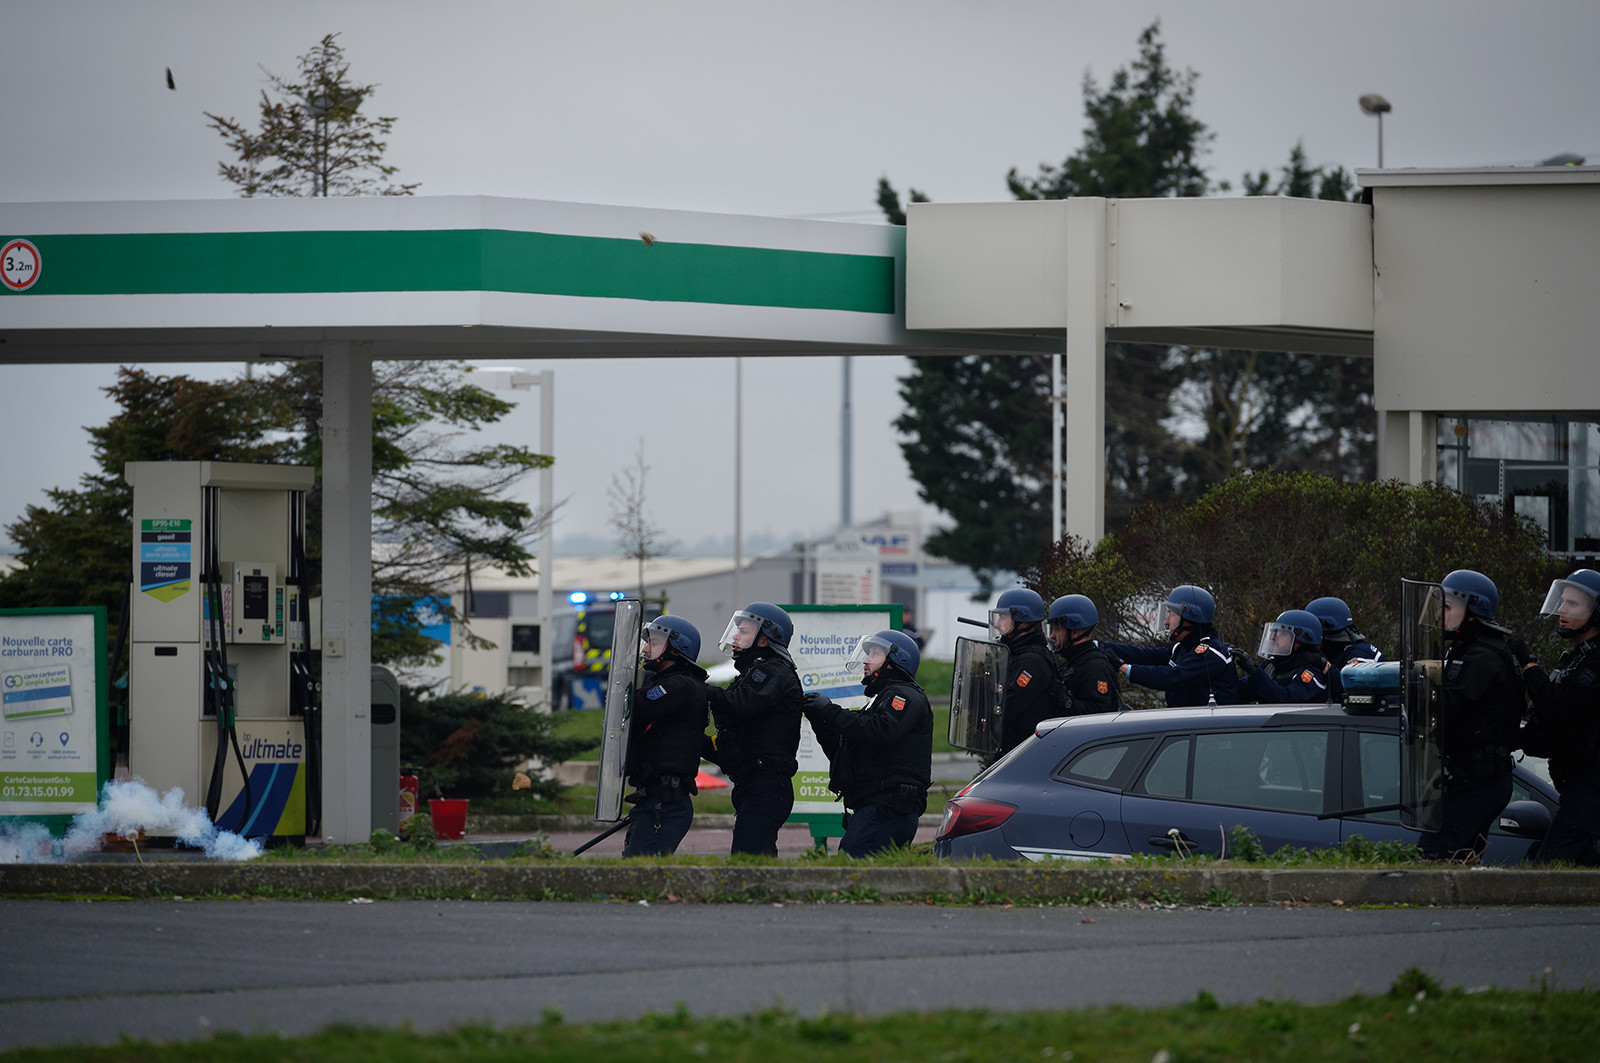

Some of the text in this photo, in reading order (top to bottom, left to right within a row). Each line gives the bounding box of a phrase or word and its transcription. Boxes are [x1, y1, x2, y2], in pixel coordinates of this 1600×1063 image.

[6, 257, 32, 271] 3.2m
[2, 636, 73, 646] Nouvelle carte
[800, 635, 842, 644] Nouvelle
[2, 647, 73, 656] carburant PRO
[800, 645, 845, 654] carburant
[4, 674, 24, 688] GO
[39, 669, 66, 678] carburant
[802, 673, 820, 686] GO
[243, 732, 251, 742] bp
[242, 738, 302, 759] ultimate
[4, 776, 71, 784] CarteCarburantGo.fr
[3, 786, 74, 797] 01.73.15.01.99
